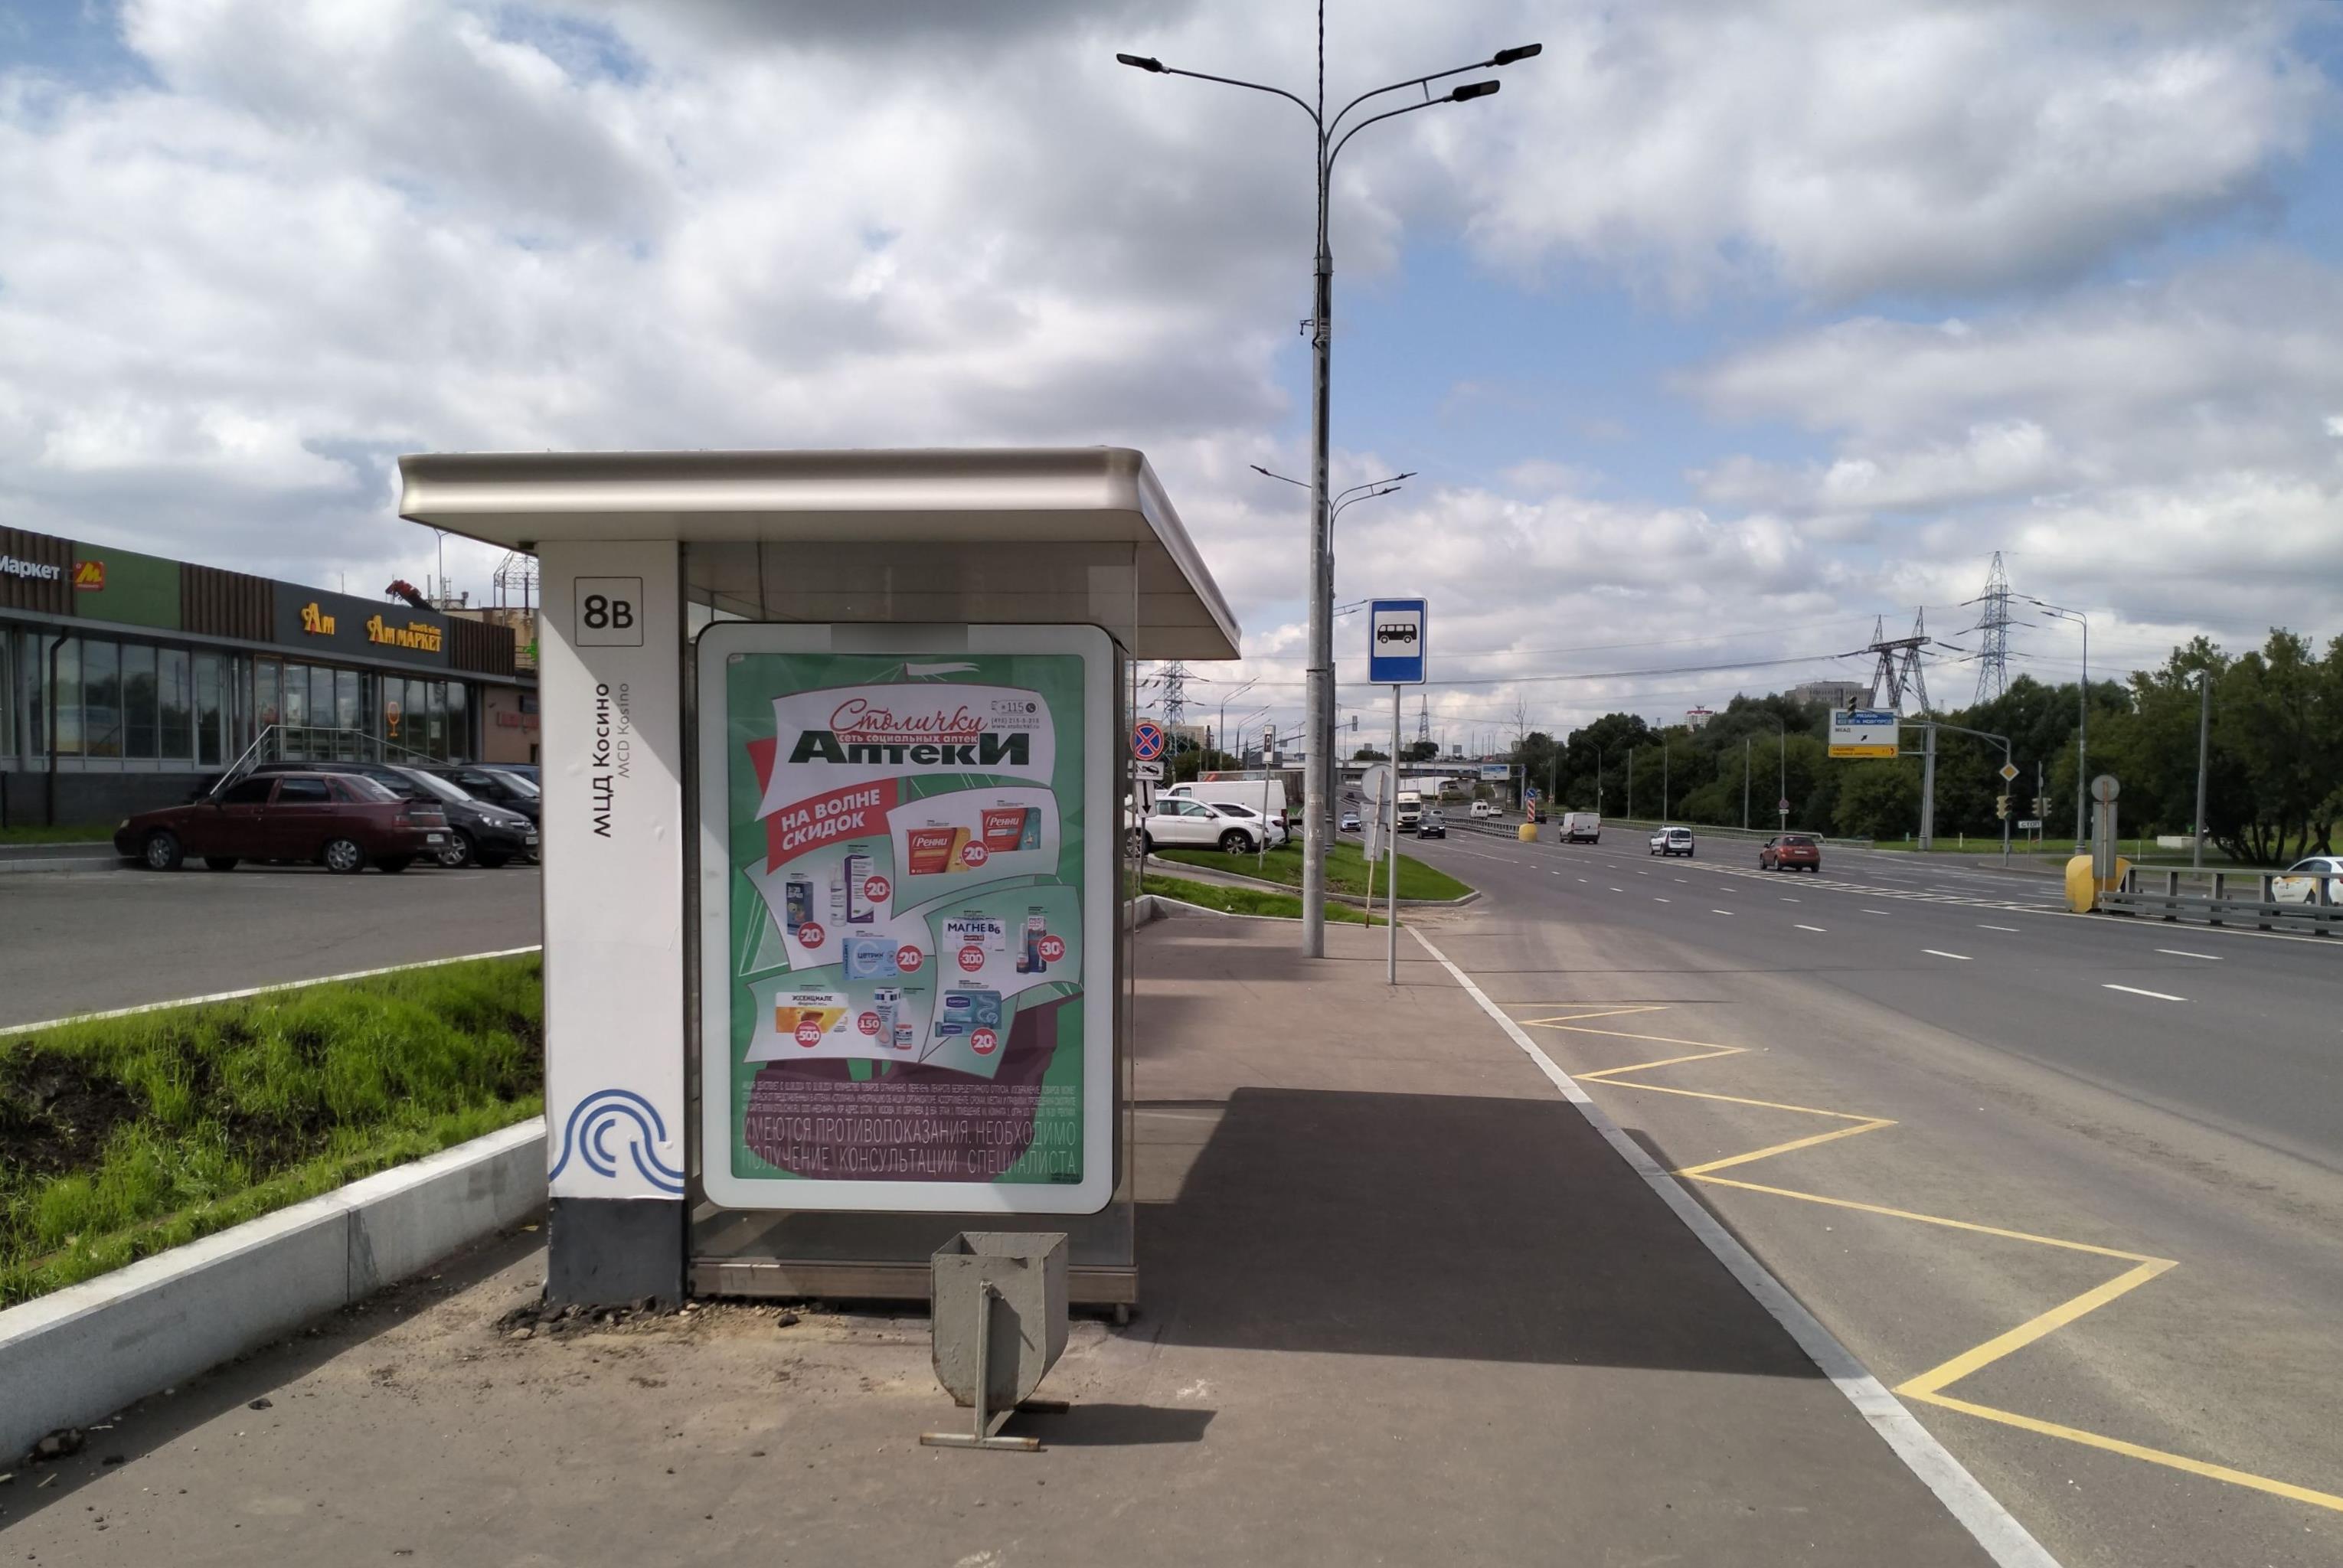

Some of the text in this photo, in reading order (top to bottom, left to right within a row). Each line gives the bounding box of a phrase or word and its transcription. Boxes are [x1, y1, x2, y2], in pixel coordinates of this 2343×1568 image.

[397, 629, 443, 652] МАРКЕТ
[829, 697, 989, 733] Столички
[617, 683, 630, 779] MCD Kosino
[839, 734, 863, 743] сеть
[866, 734, 940, 745] социальных
[593, 683, 614, 838] МЦД Косино
[782, 789, 881, 832] НА ВОЛНЕ
[990, 817, 1020, 827] Ренни
[783, 811, 865, 851] СКИДОК
[917, 838, 949, 847] Ренни
[948, 923, 986, 933] МАГНЕ
[743, 1116, 1077, 1146] ИМЕЮТСЯ ПРОТИВОПОКАЗАНИЯ. НЕОБХОДИМО
[743, 1145, 1077, 1176] ПОЛУЧЕНИЕ КОНСУЛЬТАЦИИ СПЕЦИАЛИСТА
